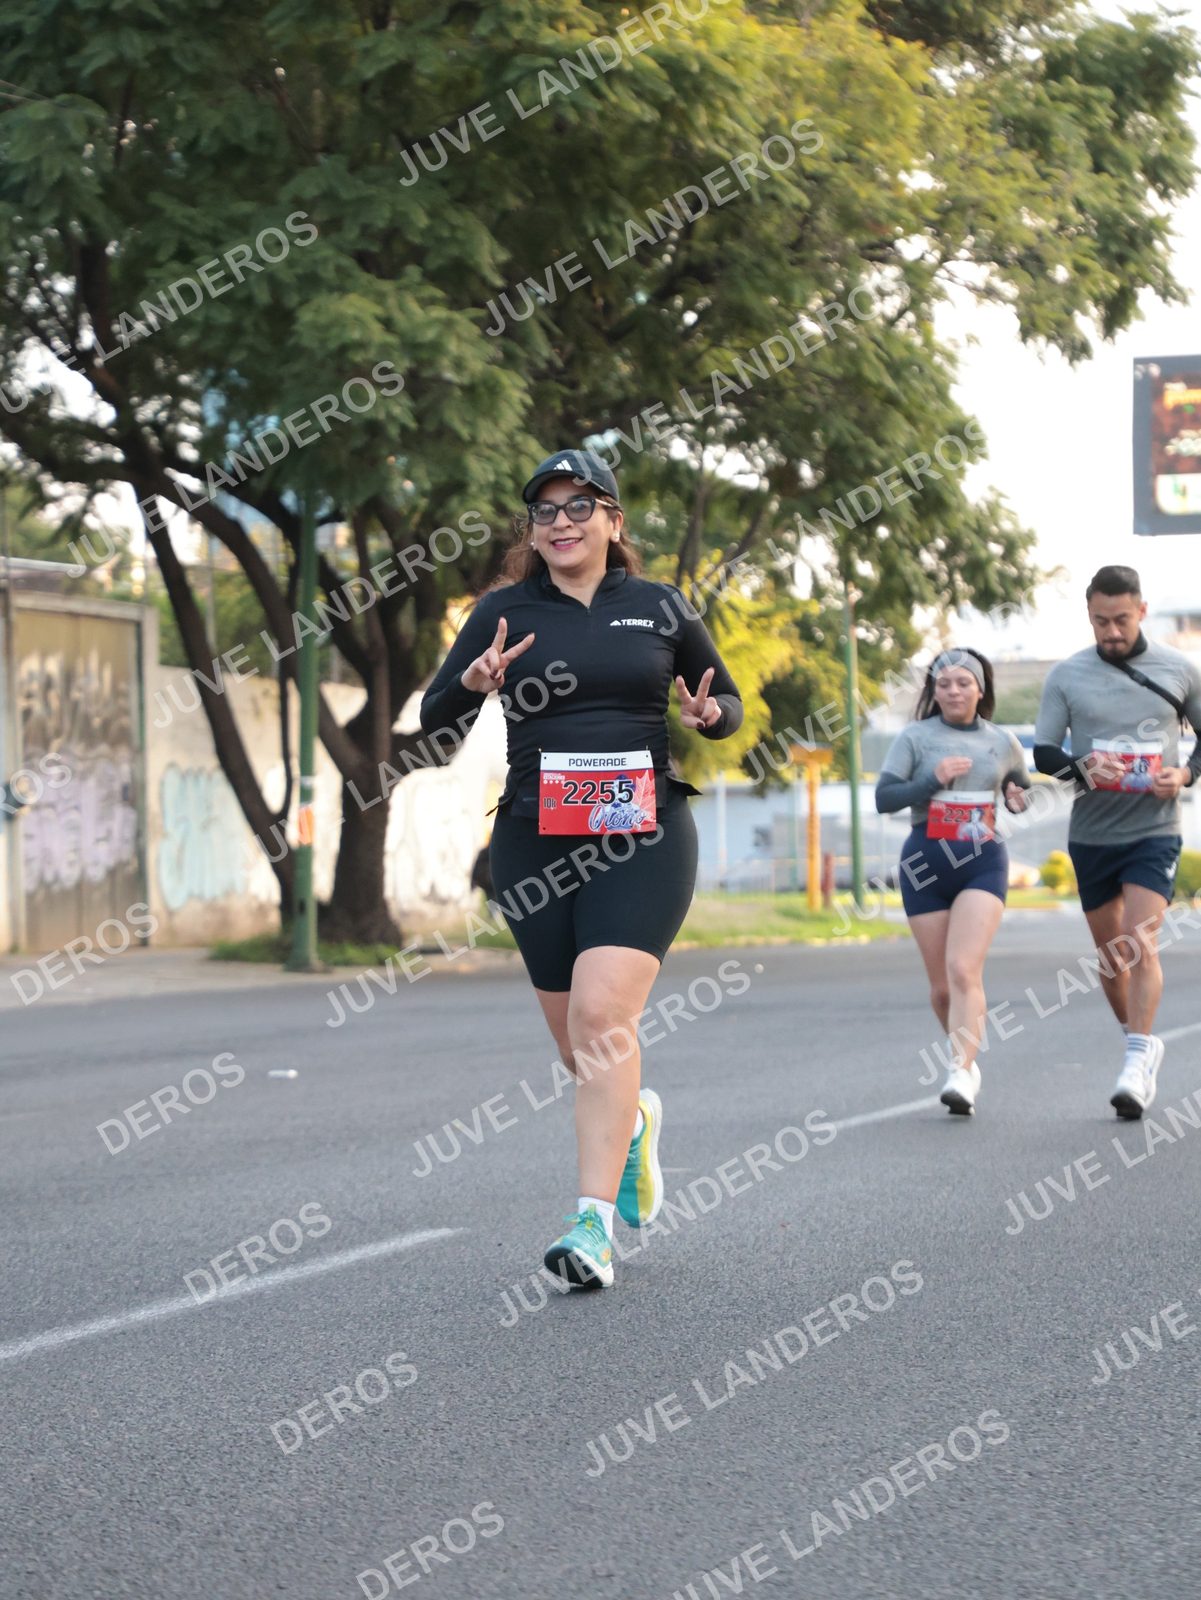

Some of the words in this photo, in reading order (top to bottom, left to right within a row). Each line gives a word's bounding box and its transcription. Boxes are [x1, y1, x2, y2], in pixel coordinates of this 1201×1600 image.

[621, 618, 654, 628] TERREX
[568, 757, 627, 767] POWERADE
[562, 780, 634, 806] 2255
